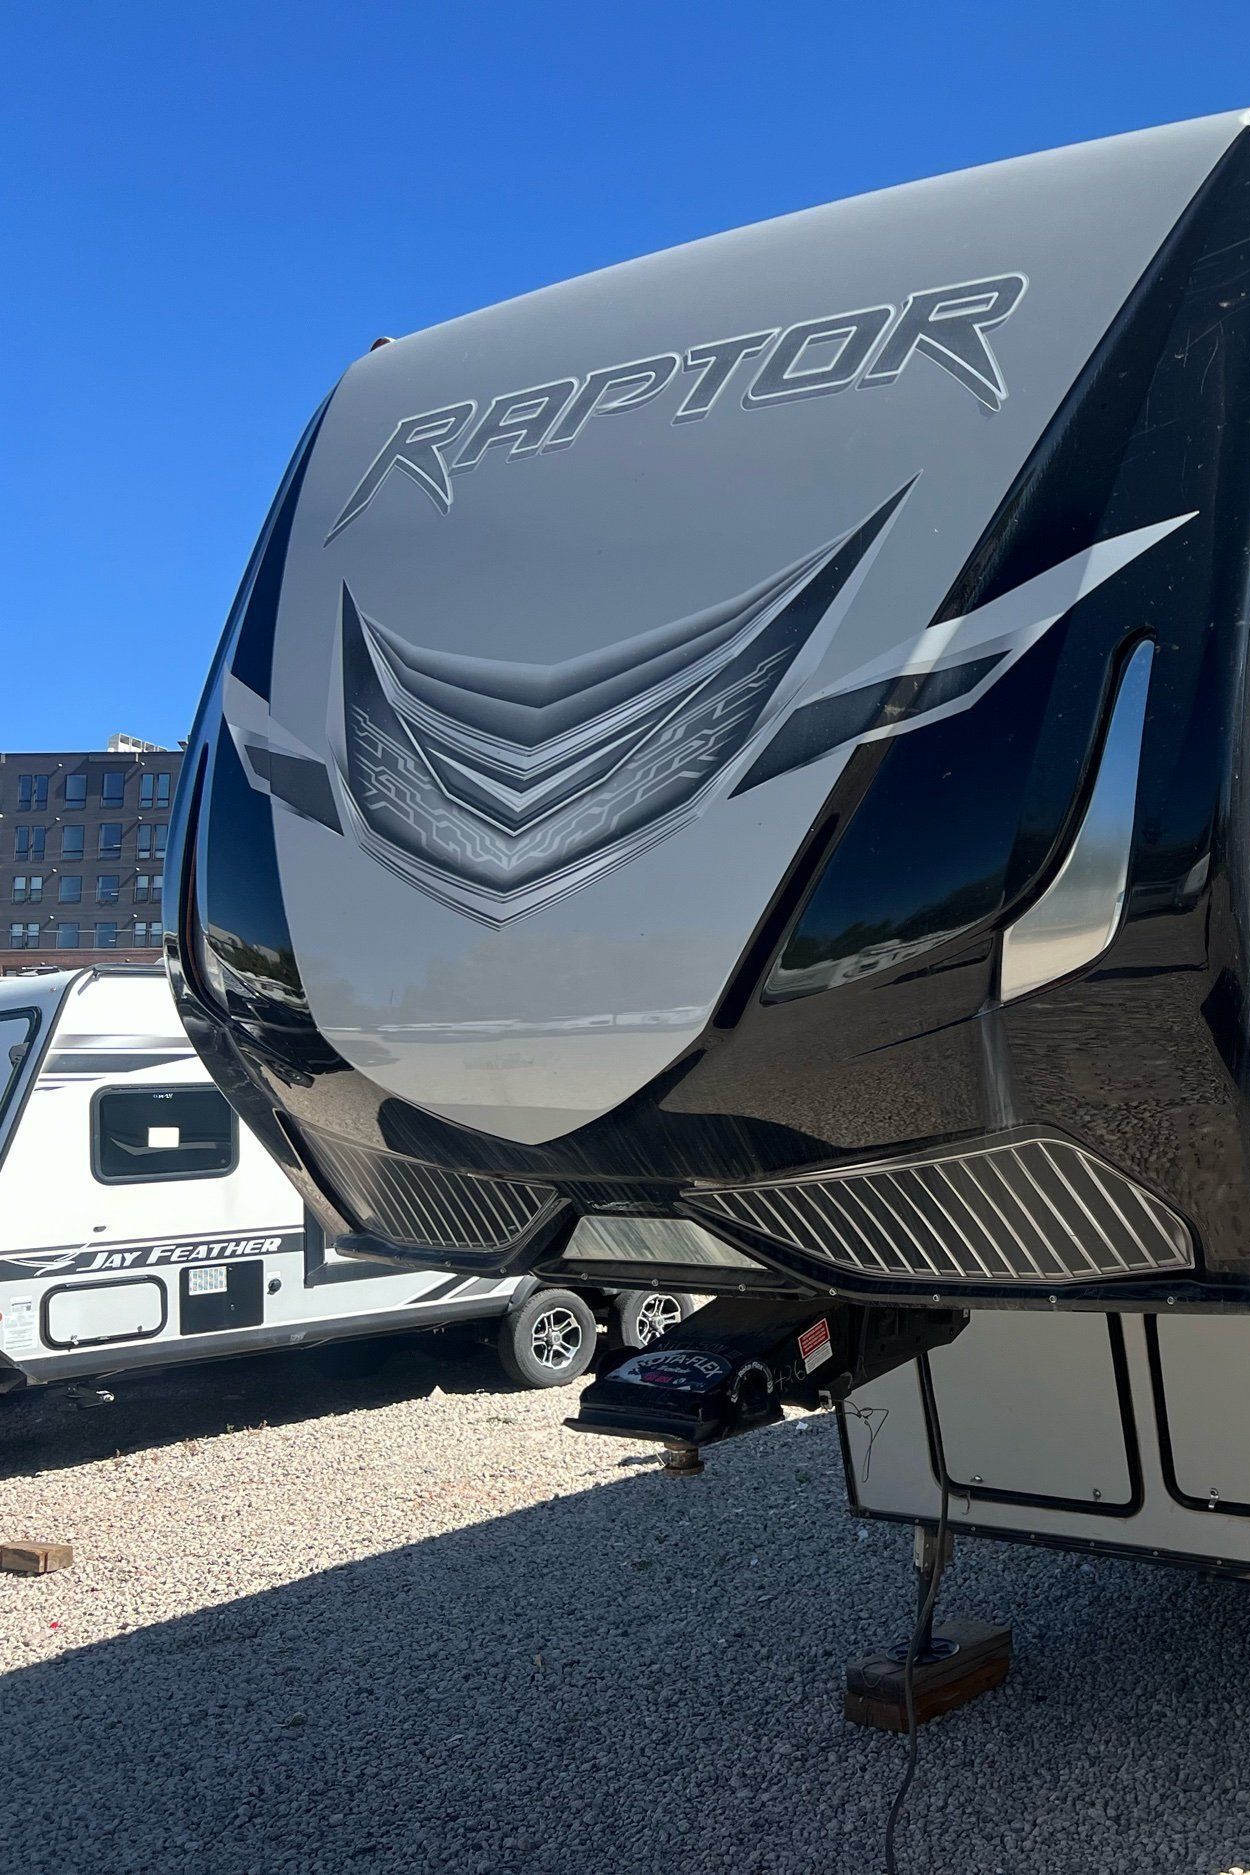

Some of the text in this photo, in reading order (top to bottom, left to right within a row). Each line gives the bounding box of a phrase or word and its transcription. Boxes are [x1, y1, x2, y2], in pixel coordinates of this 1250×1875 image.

[323, 270, 1030, 549] RAPTOR
[76, 1238, 282, 1272] JAY FEATHER
